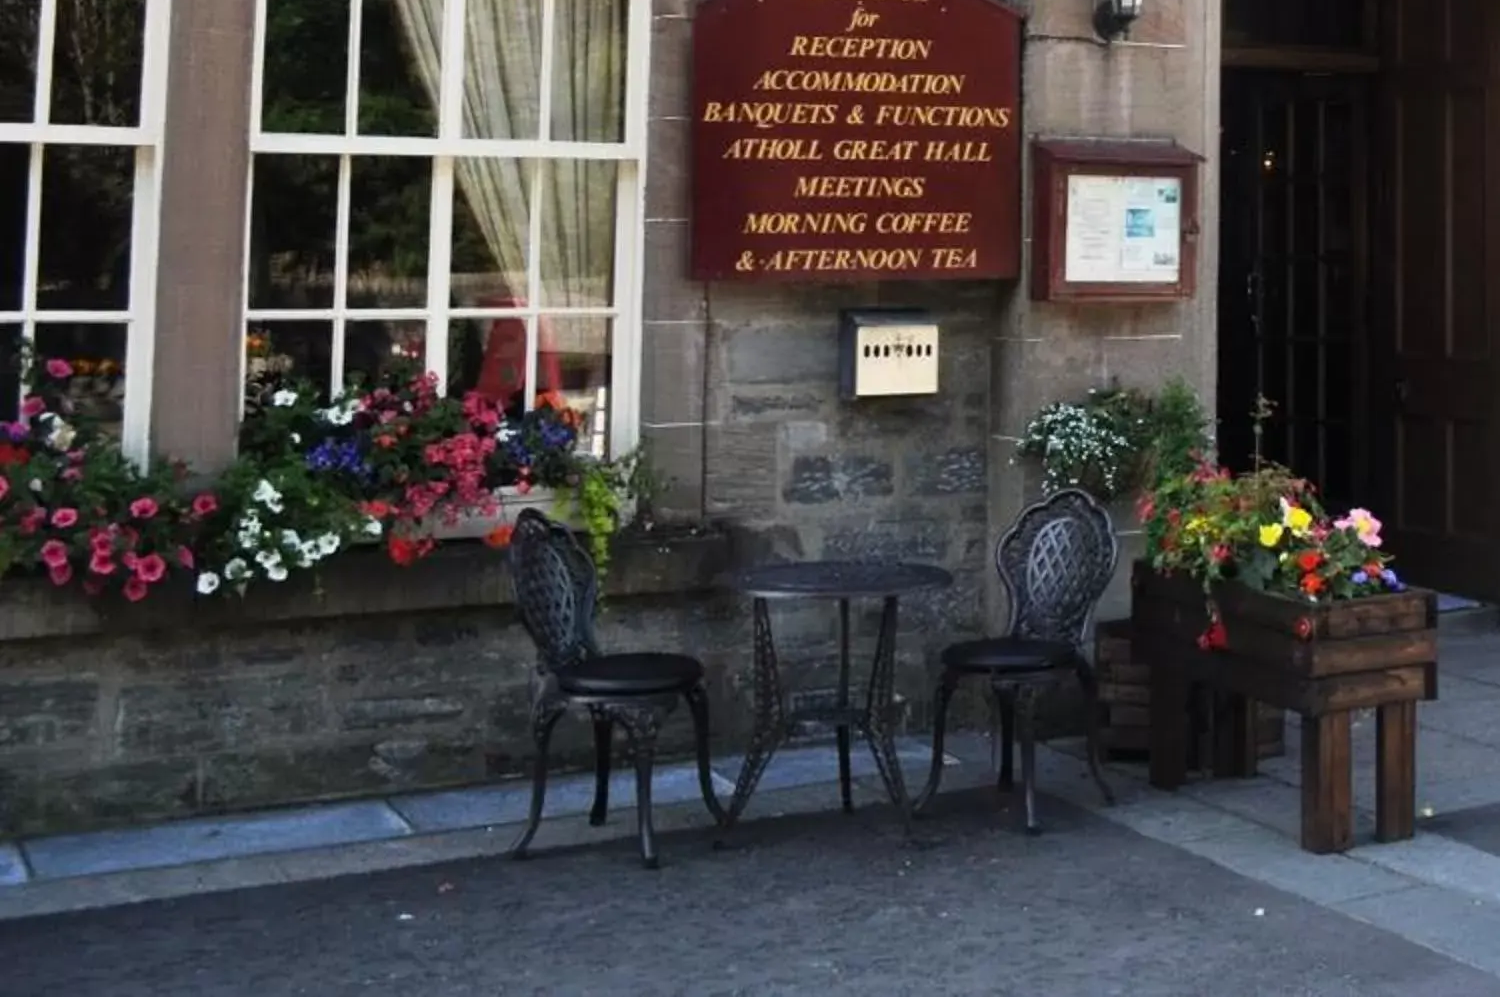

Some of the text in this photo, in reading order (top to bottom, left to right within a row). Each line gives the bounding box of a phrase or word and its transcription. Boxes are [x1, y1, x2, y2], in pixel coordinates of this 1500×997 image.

[846, 6, 880, 32] for
[789, 36, 932, 60] RECEPTION
[753, 69, 966, 94] ACCOMMODATION
[703, 102, 1011, 128] BANQUETS & FUNCTIONS
[722, 138, 993, 163] ATHOLL GREAT HALL
[793, 176, 926, 198] MEETINGS
[743, 212, 972, 235] MORNING COFFEE
[735, 248, 978, 272] & AFTERNOON TEA
